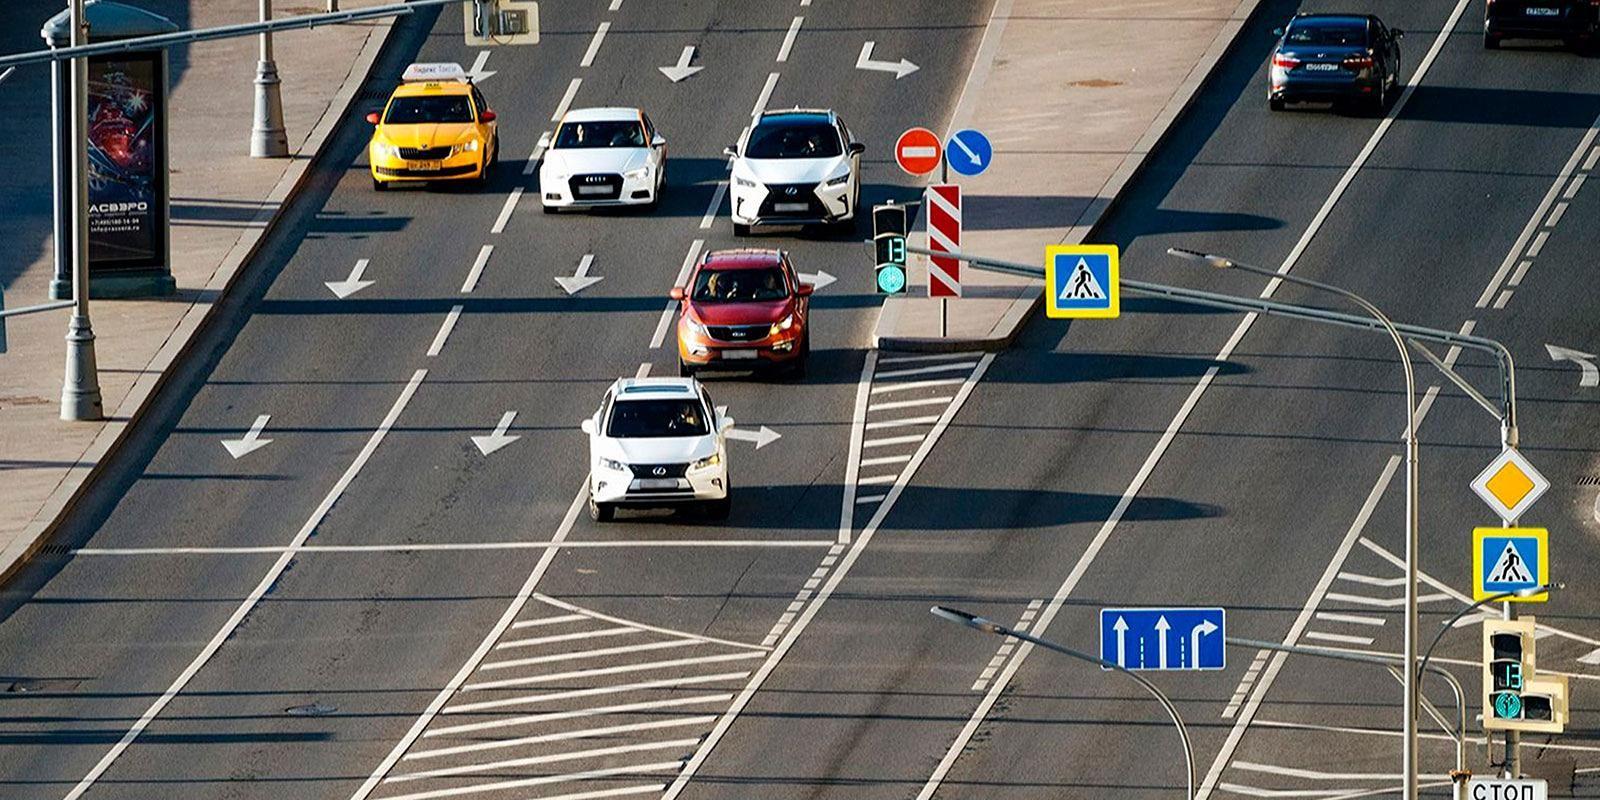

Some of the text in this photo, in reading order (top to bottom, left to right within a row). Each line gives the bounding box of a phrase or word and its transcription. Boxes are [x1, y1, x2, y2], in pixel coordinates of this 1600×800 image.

[89, 202, 148, 213] АСВЭРО
[888, 238, 905, 263] 13
[1506, 664, 1522, 688] 13
[1473, 784, 1534, 800] СТОП
